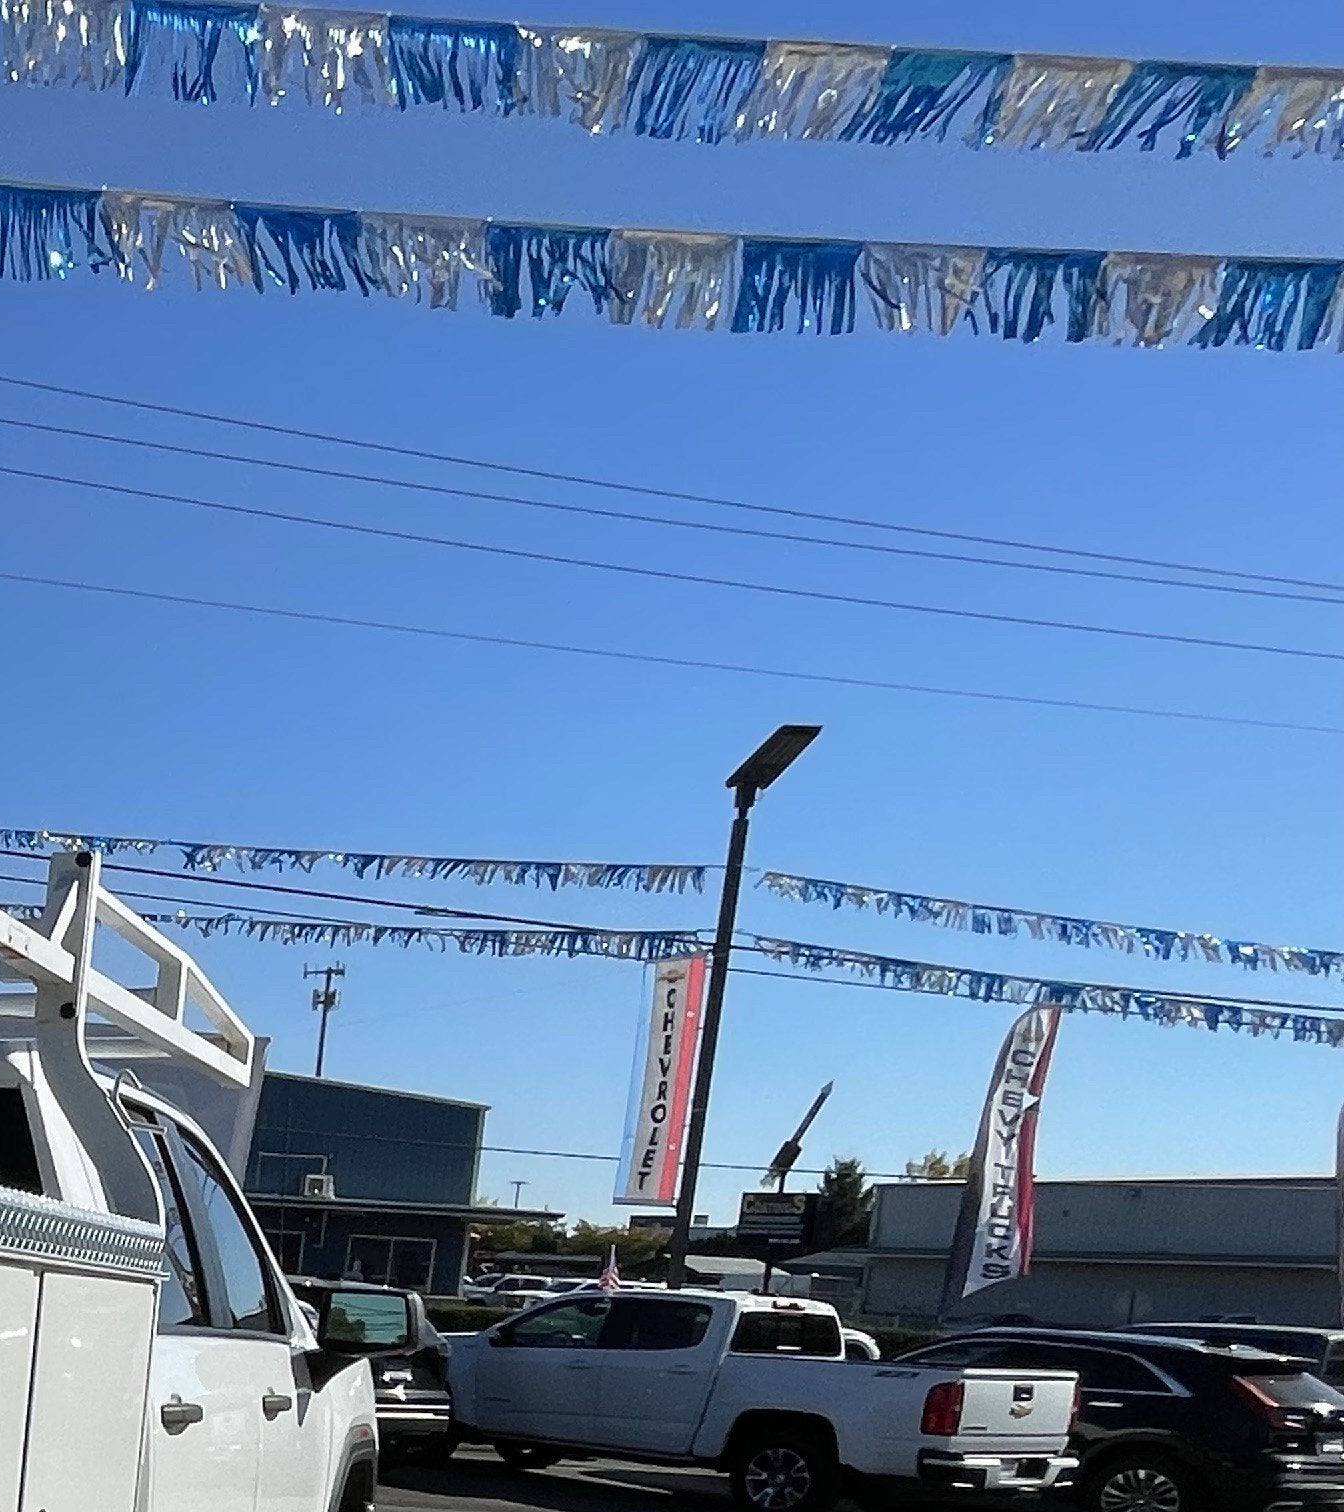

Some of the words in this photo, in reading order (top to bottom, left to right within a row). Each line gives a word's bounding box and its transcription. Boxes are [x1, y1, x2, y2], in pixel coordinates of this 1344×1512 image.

[637, 988, 677, 1191] CHEVROLET
[996, 1050, 1035, 1158] CHEVY
[981, 1162, 1015, 1280] TRUCKS
